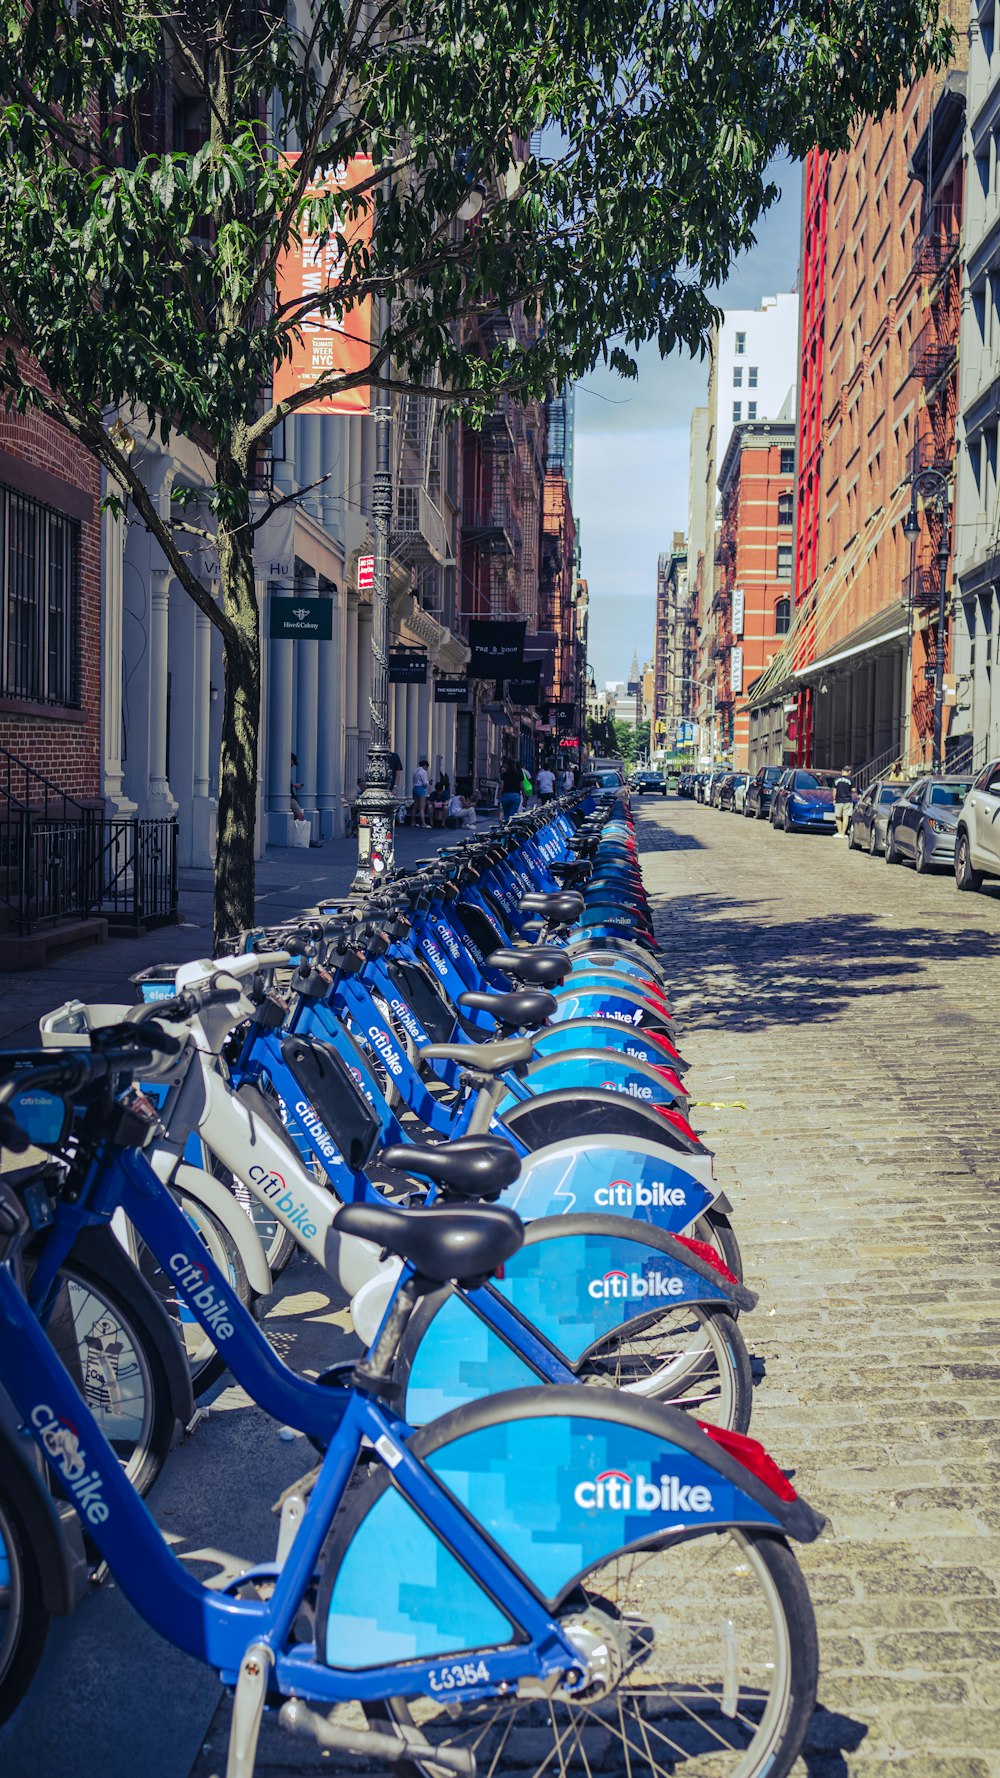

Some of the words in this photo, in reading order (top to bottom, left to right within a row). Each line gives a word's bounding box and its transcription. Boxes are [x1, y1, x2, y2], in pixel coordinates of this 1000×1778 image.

[312, 355, 333, 366] NYC
[313, 347, 333, 355] WEEK
[732, 649, 740, 691] PRADA
[493, 889, 503, 901] citi
[501, 898, 512, 914] bike
[422, 939, 439, 956] citi
[437, 925, 452, 941] citi
[445, 937, 461, 959] bike
[463, 934, 473, 948] citi
[470, 944, 484, 963] bike
[430, 952, 448, 976] bike
[390, 999, 408, 1017] citi
[401, 1012, 419, 1037] bike
[368, 1026, 389, 1048] citi
[380, 1044, 403, 1076] bike
[295, 1101, 317, 1126] citi
[308, 1121, 335, 1158] bike
[249, 1165, 285, 1199] citi
[275, 1190, 317, 1239] bike
[594, 1180, 632, 1206] citi
[636, 1182, 686, 1206] bike
[169, 1253, 208, 1293] citi
[192, 1285, 235, 1340] bike
[588, 1270, 628, 1298] citi
[631, 1271, 684, 1297] bike
[574, 1470, 632, 1509] citi
[636, 1474, 714, 1512] bike
